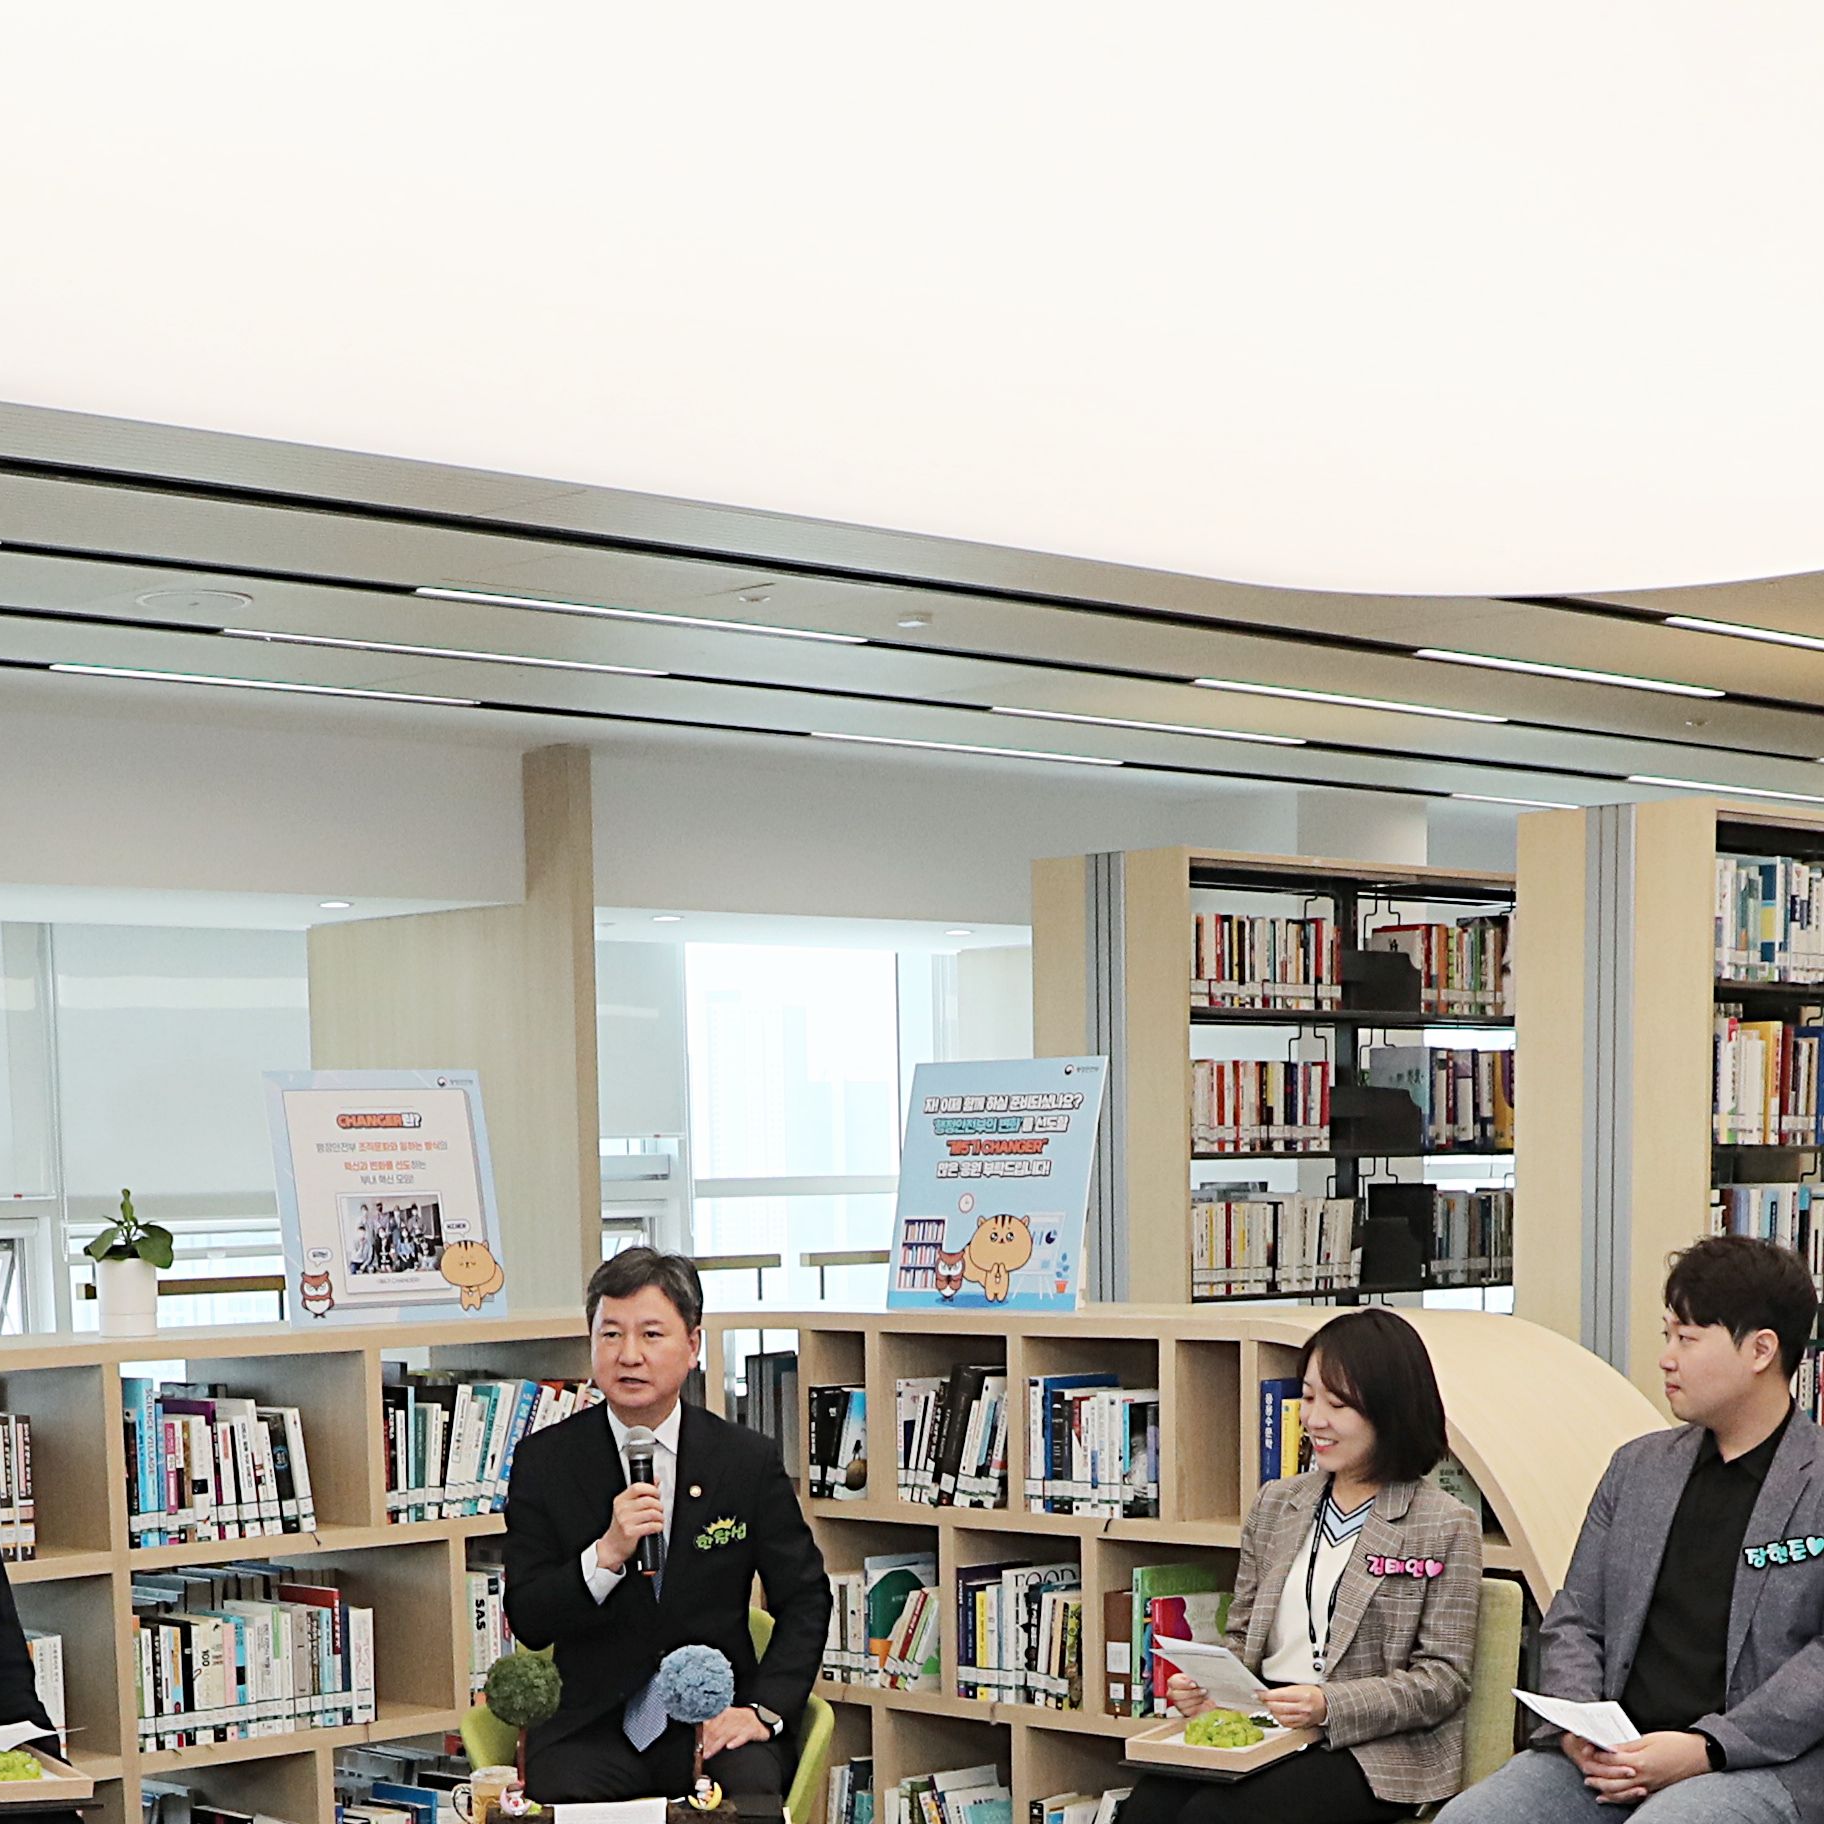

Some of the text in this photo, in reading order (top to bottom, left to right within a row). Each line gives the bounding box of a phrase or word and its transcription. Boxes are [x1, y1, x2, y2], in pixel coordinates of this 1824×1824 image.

[941, 1096, 963, 1113] 이제
[963, 1095, 985, 1112] 함께
[986, 1094, 1008, 1112] 하실
[1009, 1092, 1083, 1111] 준비되셨나요?
[1035, 1115, 1069, 1133] 선도할
[937, 1160, 1051, 1178] 많은 응원 부탁드립니다!
[144, 1387, 156, 1476] SCIENCE VILLAGE
[475, 1598, 486, 1631] SAS
